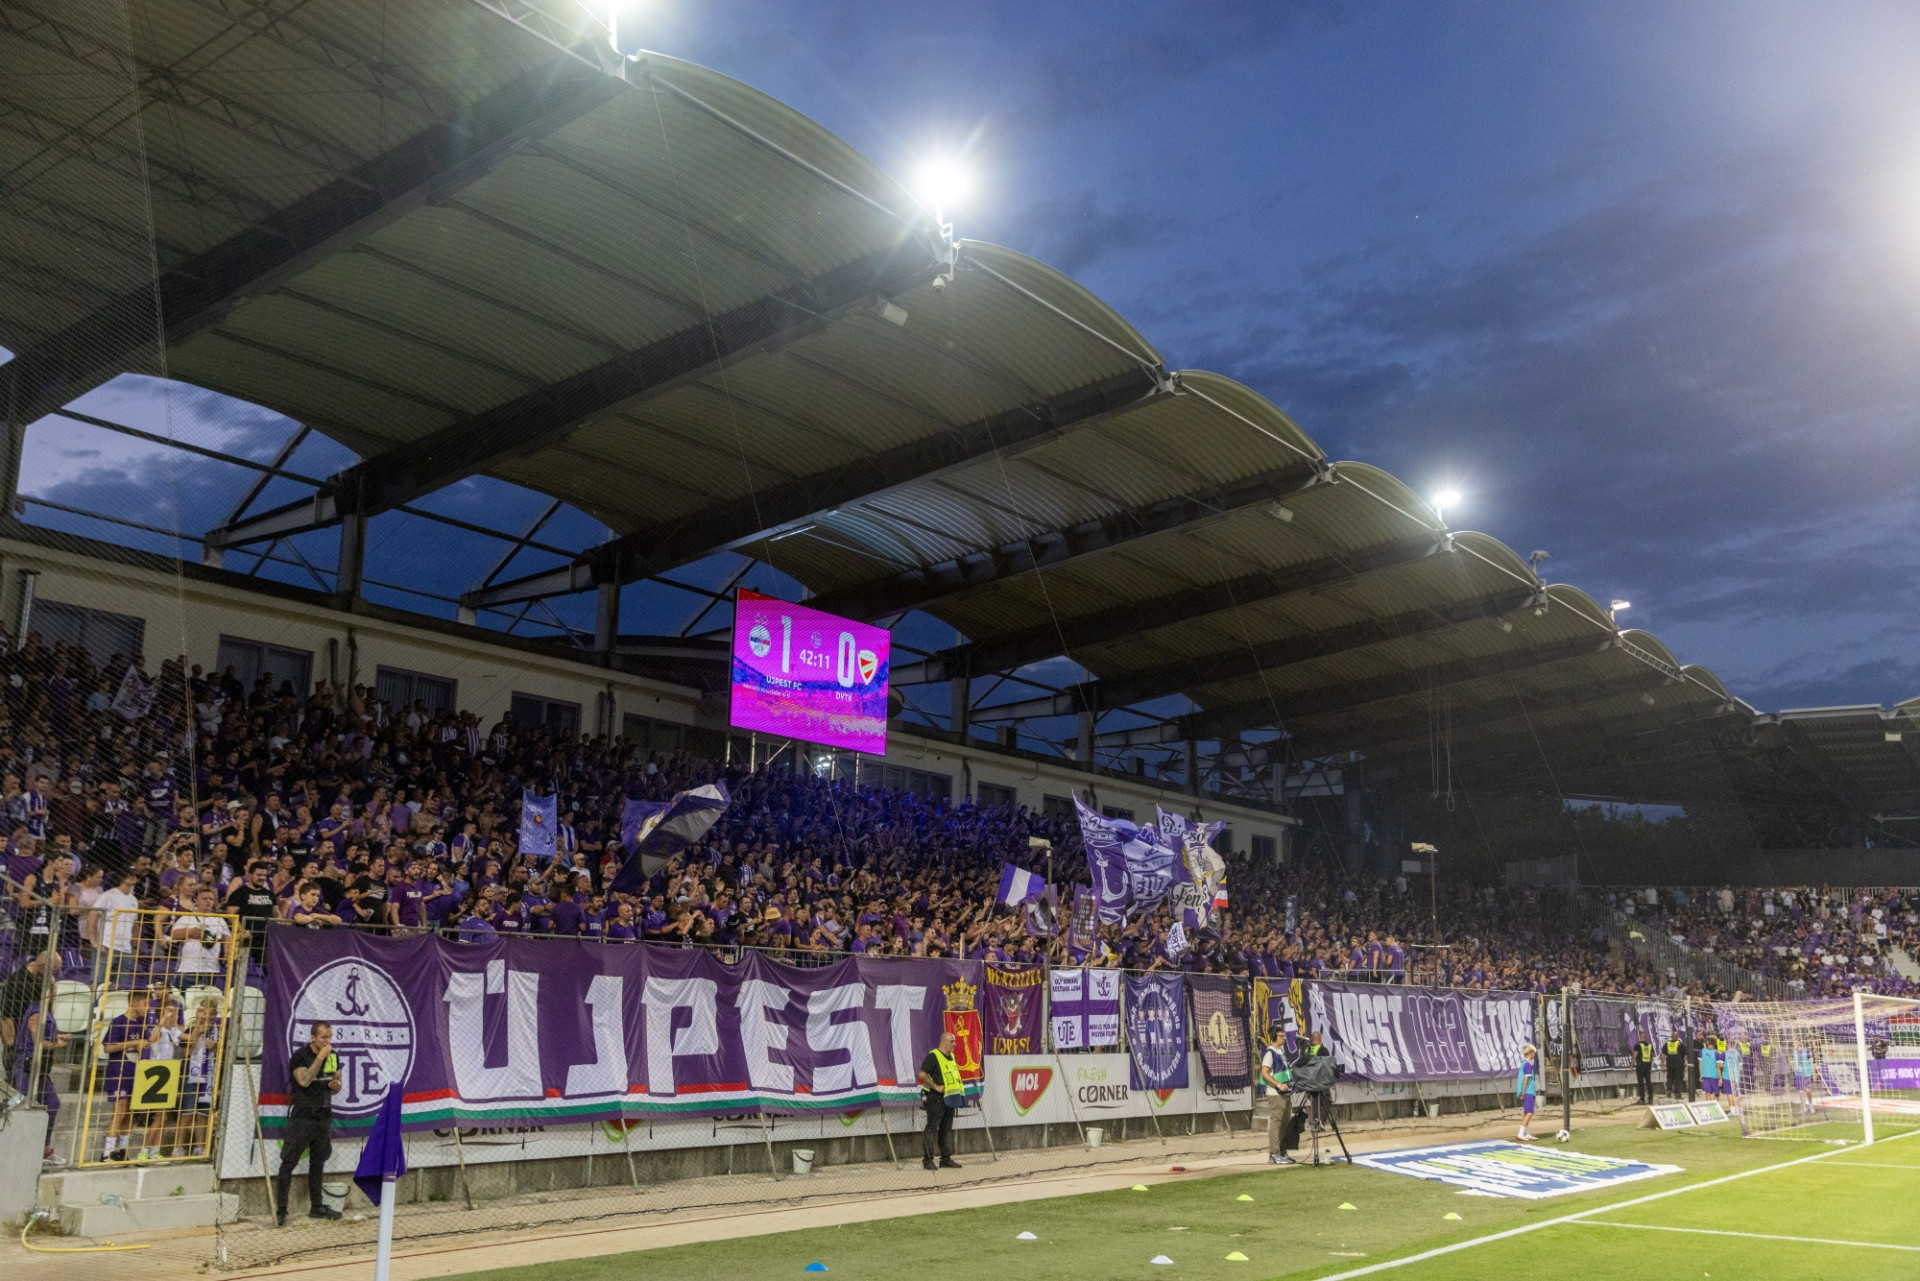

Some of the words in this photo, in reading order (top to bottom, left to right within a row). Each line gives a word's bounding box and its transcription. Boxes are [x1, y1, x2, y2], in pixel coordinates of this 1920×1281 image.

[781, 615, 792, 673] 1
[799, 649, 830, 670] 42:11
[837, 631, 856, 688] 0
[835, 691, 853, 702] DVTK
[443, 959, 927, 1098] ÚJPEST
[1015, 1072, 1039, 1091] MOL
[1077, 1066, 1107, 1081] FRESH
[141, 1065, 170, 1104] 2
[1078, 1084, 1129, 1103] CORNER
